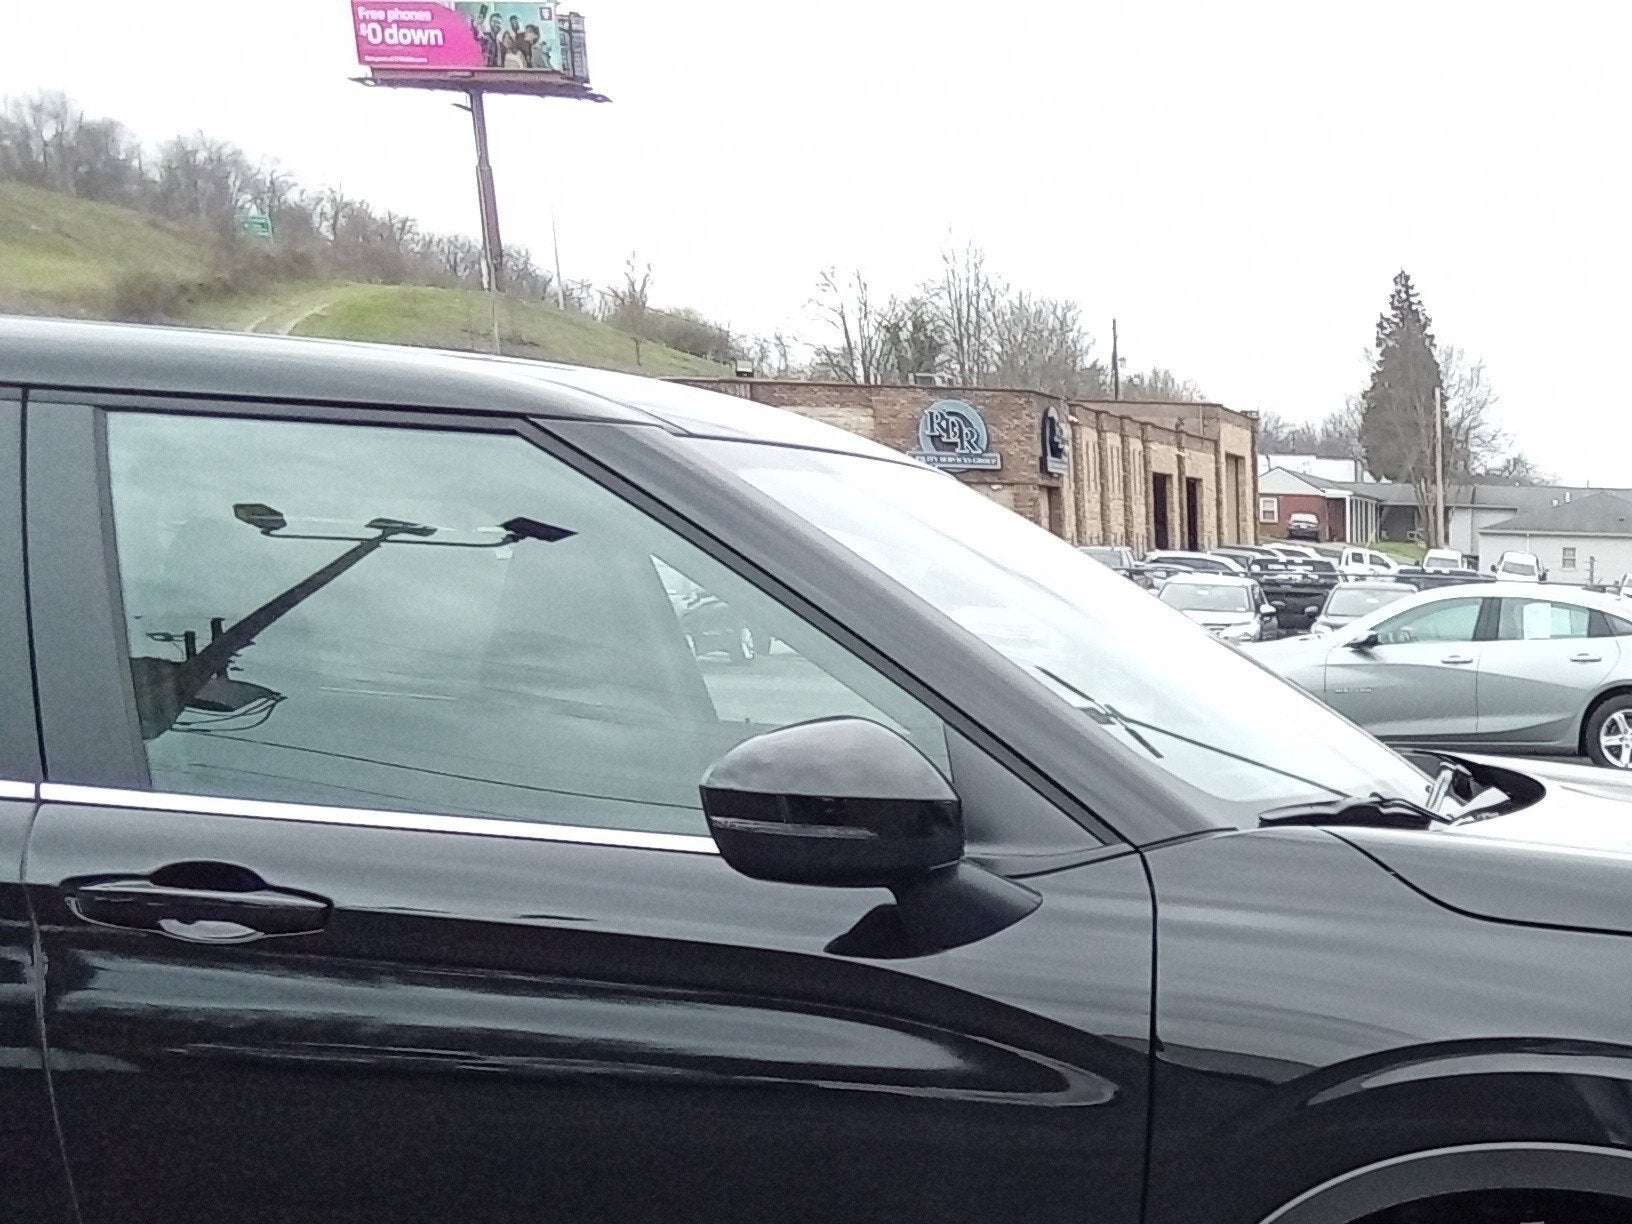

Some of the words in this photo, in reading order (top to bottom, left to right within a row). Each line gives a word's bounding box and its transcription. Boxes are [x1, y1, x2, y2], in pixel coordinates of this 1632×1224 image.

[357, 6, 386, 21] Free
[386, 7, 432, 22] phones
[384, 23, 444, 46] down
